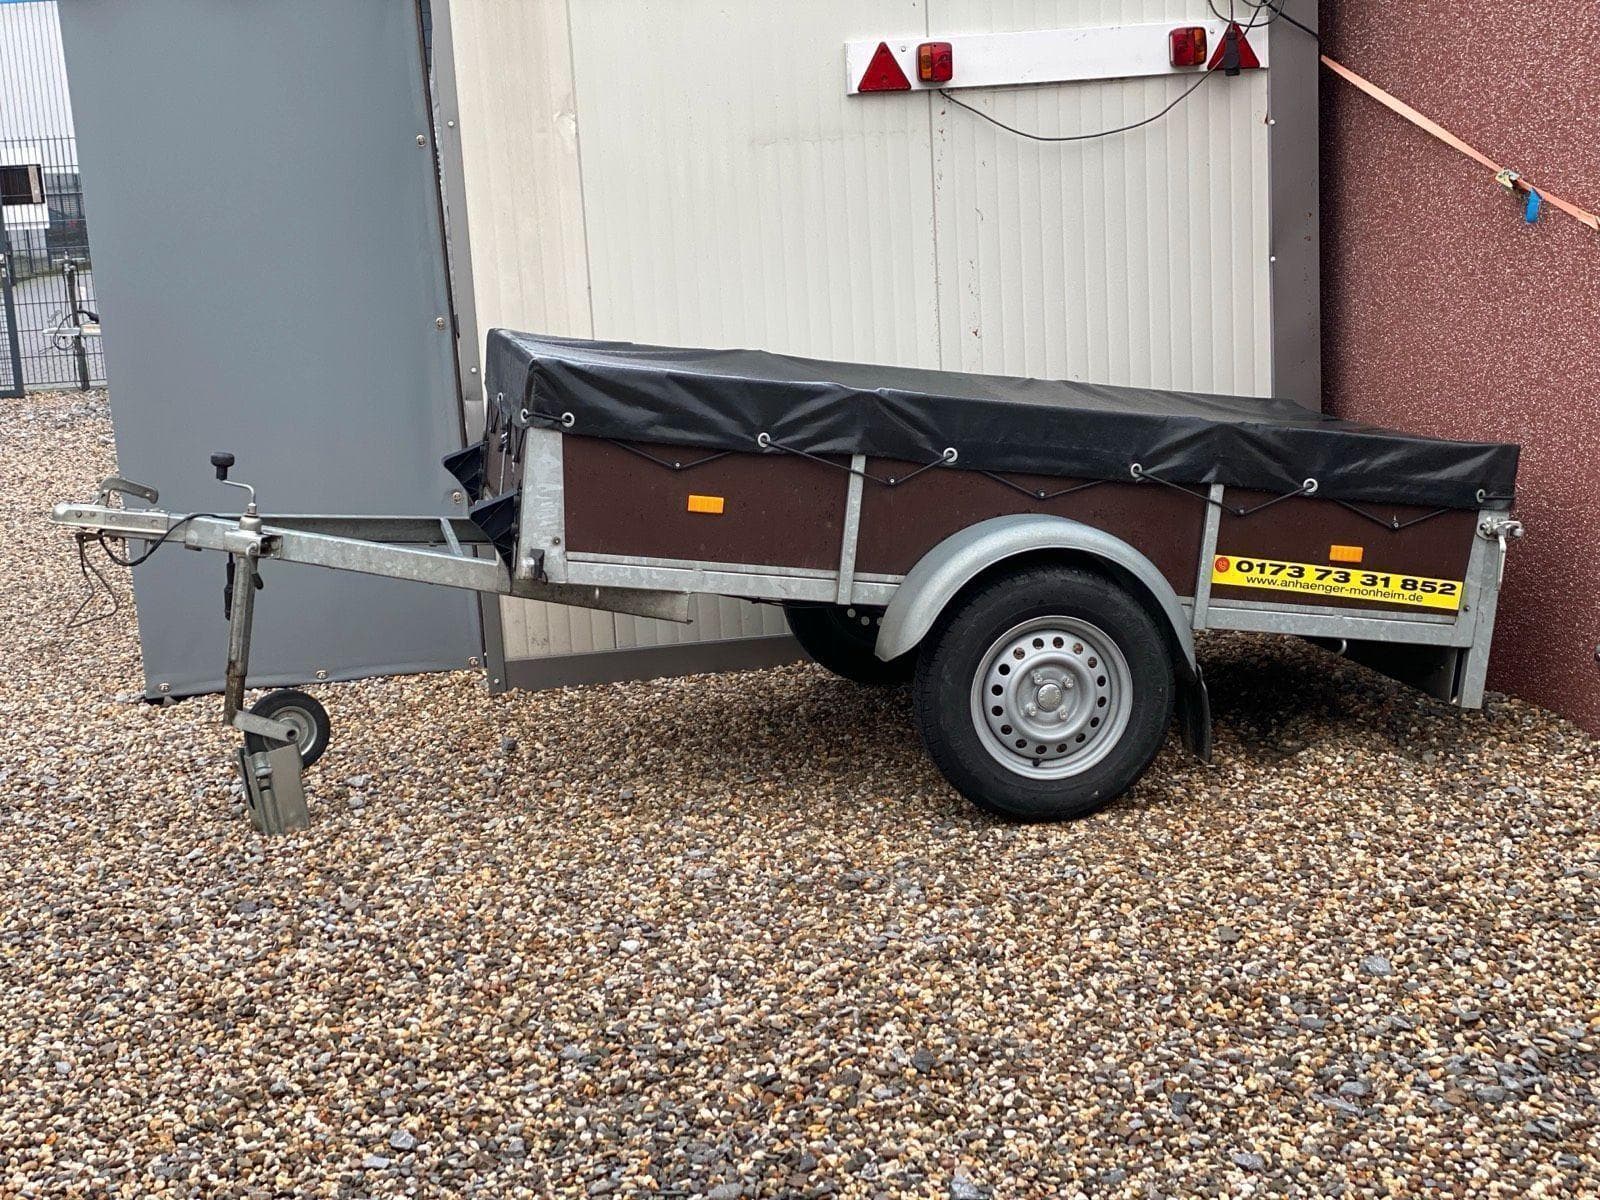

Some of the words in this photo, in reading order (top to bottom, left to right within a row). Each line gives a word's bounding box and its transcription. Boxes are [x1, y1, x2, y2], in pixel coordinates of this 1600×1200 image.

[1236, 560, 1305, 578] 0173
[1315, 567, 1351, 583] 73
[1360, 573, 1390, 588] 31
[1400, 578, 1457, 596] 852
[1246, 575, 1424, 603] www.anhaenger-monheim.de
